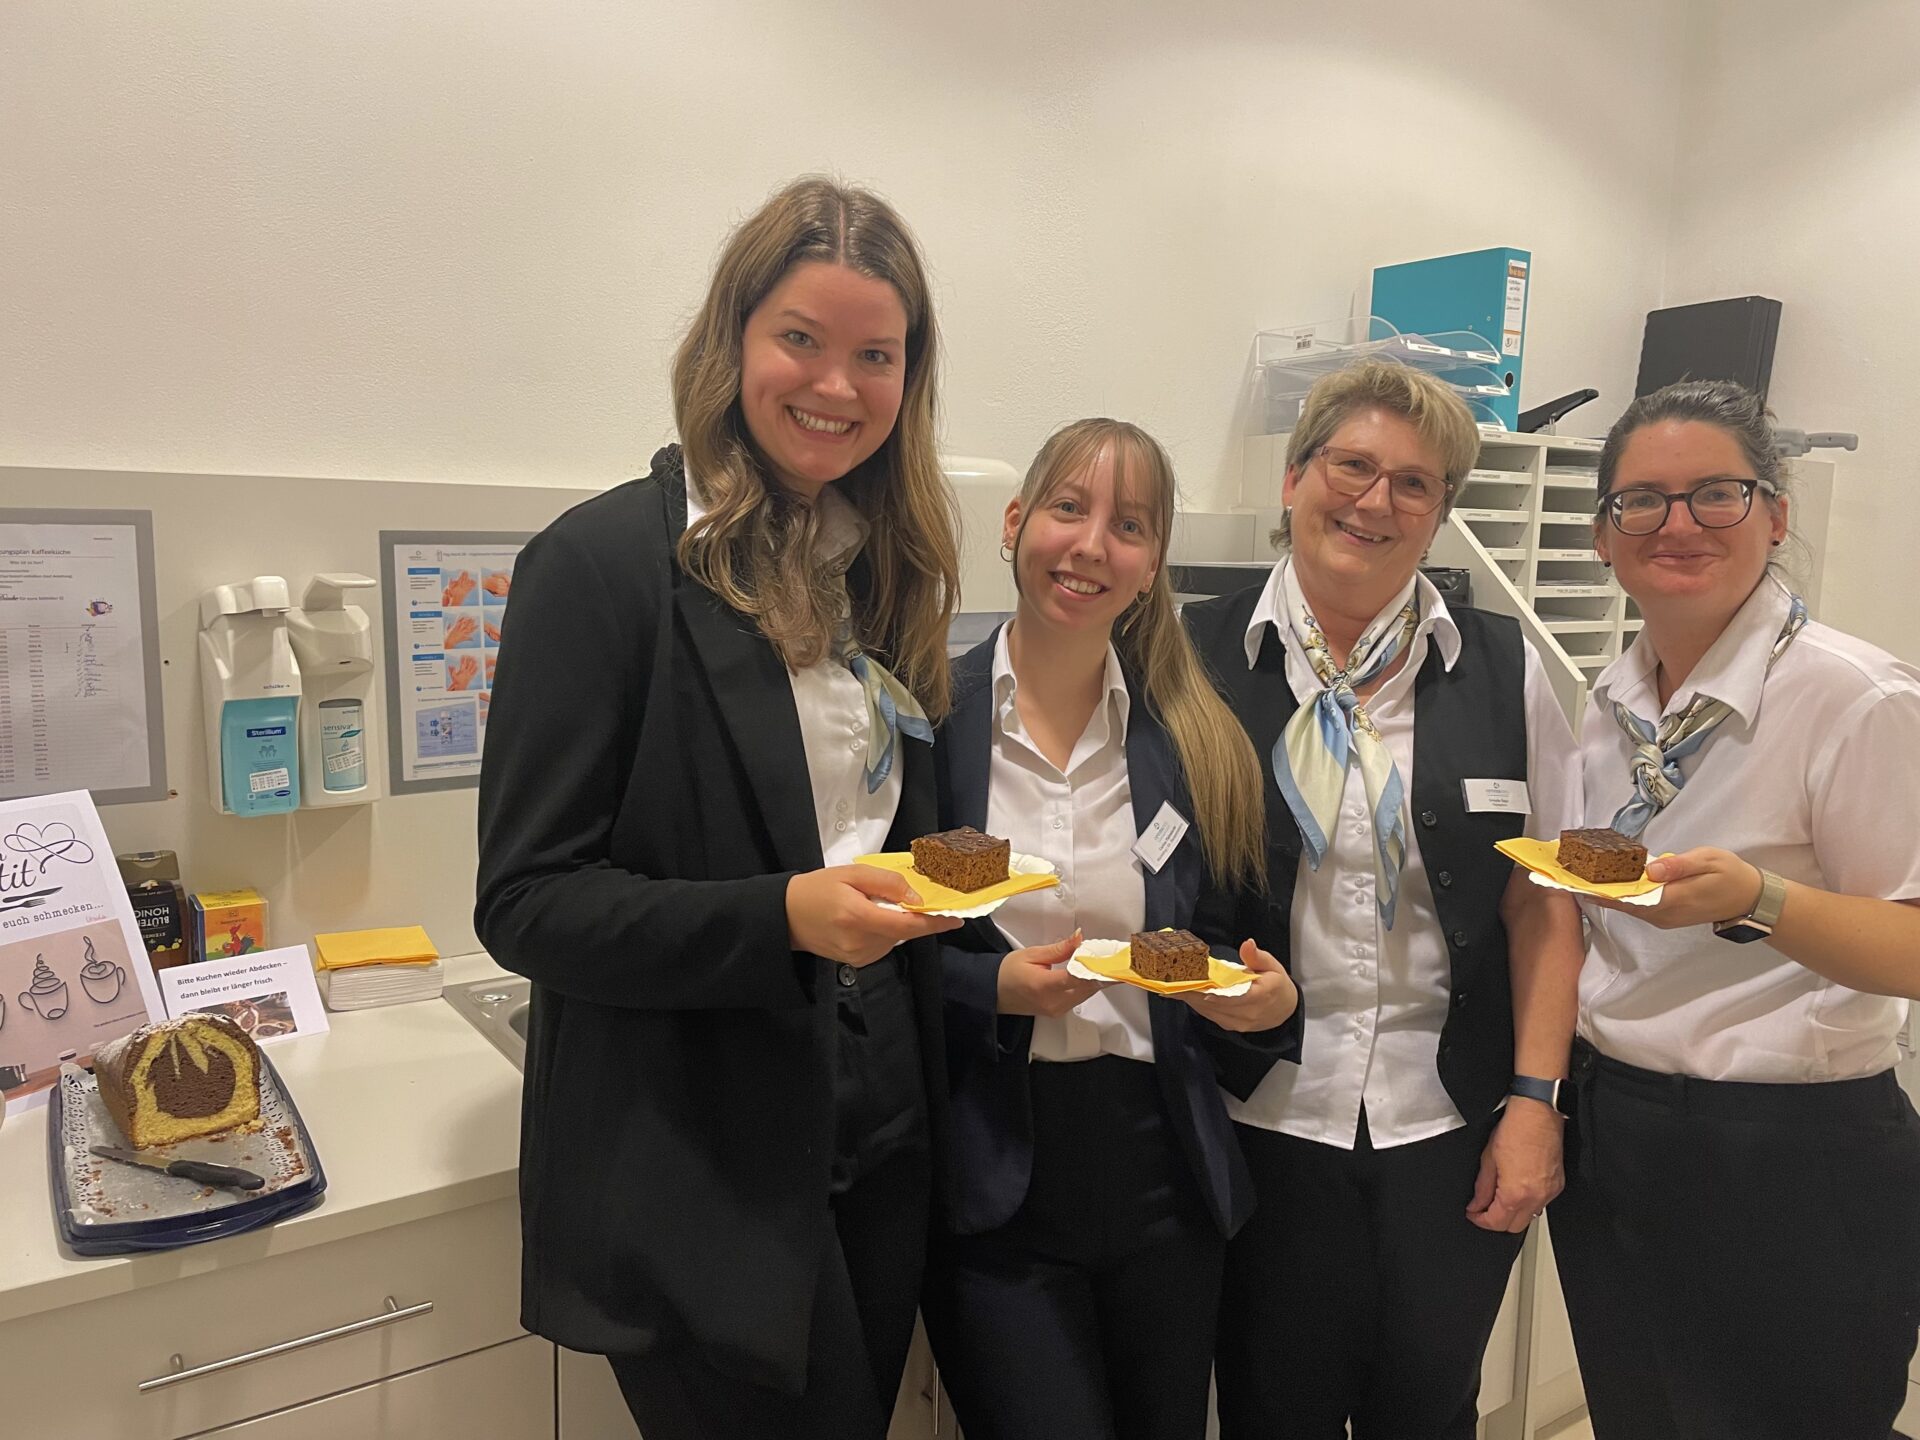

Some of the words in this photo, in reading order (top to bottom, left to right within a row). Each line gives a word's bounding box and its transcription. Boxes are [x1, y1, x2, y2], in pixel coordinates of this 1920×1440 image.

[2, 914, 30, 929] euch
[177, 977, 195, 986] Bitte
[195, 972, 223, 983] Kuchen
[223, 968, 247, 977] wieder
[249, 961, 282, 973] Abdecken
[180, 990, 199, 1000] dann
[200, 985, 221, 996] bleibt
[231, 980, 253, 991] länger
[254, 976, 273, 986] frisch
